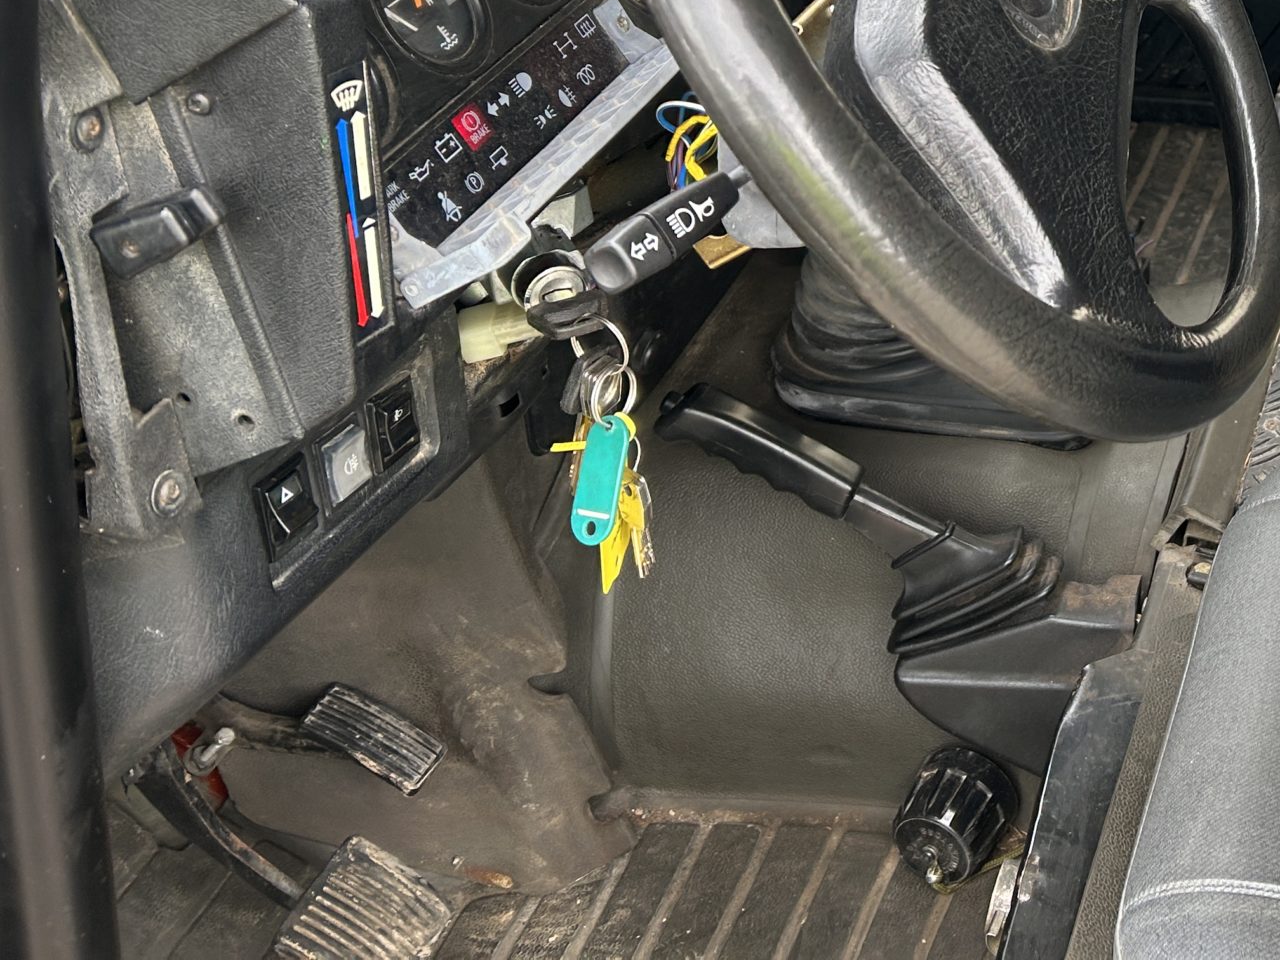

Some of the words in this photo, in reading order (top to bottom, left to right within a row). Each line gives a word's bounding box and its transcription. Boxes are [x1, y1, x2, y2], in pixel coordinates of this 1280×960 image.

[469, 123, 492, 145] BRAKE
[385, 180, 401, 199] ARK
[387, 189, 410, 213] BRAKE
